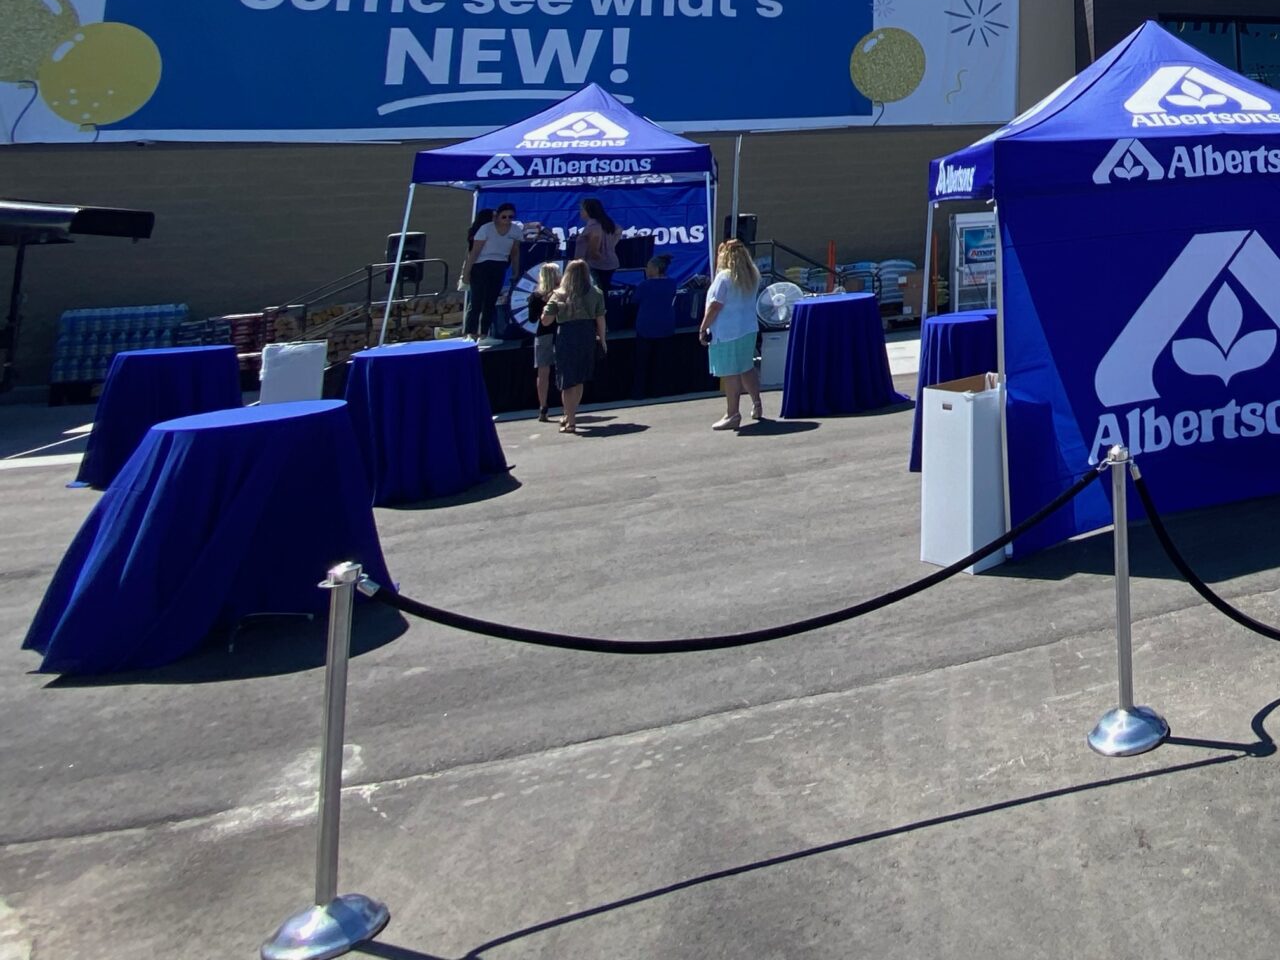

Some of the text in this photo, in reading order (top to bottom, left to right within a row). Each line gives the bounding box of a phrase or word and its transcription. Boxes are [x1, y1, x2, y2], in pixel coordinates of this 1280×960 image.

[384, 26, 630, 85] NEW!
[515, 138, 627, 150] Albertsons
[526, 157, 652, 176] Albertsons
